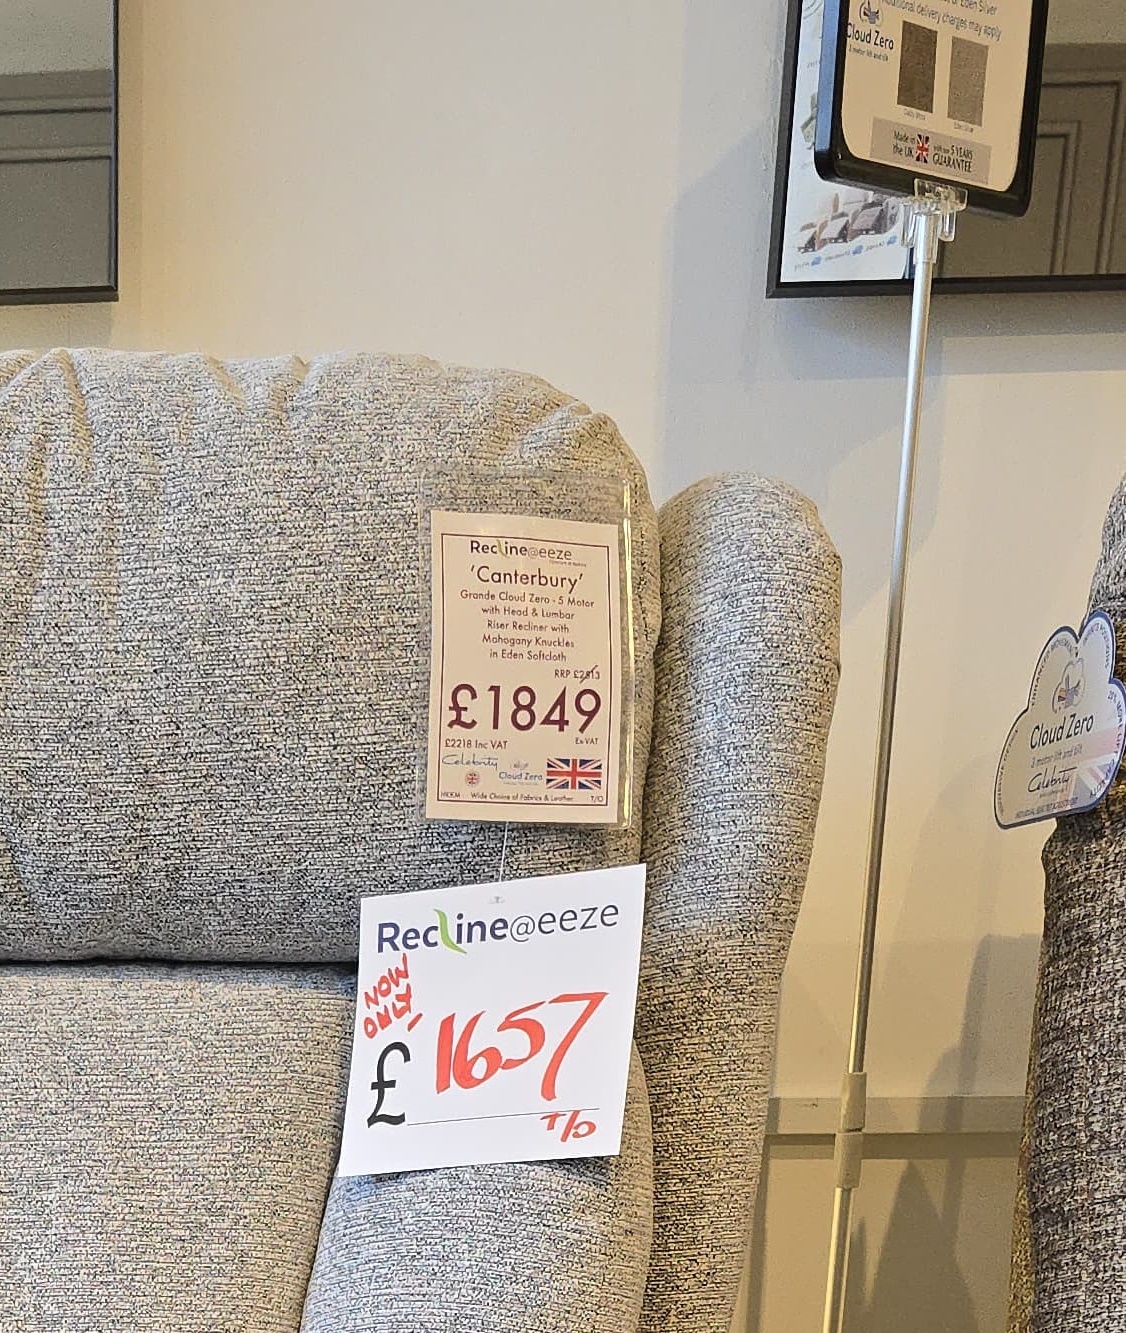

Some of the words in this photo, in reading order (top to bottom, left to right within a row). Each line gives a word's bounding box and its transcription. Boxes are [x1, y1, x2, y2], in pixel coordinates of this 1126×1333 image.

[917, 4, 940, 24] delivery
[942, 11, 967, 31] charges
[969, 21, 982, 36] may
[984, 25, 1002, 42] apply
[846, 22, 871, 44] Cloud
[874, 31, 894, 50] Zero
[894, 130, 909, 143] Made
[893, 143, 903, 155] the
[905, 146, 914, 159] UK
[956, 146, 973, 160] YEARS
[933, 152, 972, 173] GUARANTEE
[470, 539, 572, 560] Recline@eeze
[471, 565, 583, 594] 'Canterbury'
[460, 590, 495, 600] Grande
[499, 591, 525, 602] Cloud
[529, 593, 550, 604] Zero
[558, 596, 563, 605] 5
[567, 597, 594, 608] Motor
[481, 606, 500, 615] with
[504, 606, 528, 617] Head
[531, 609, 538, 617] &
[541, 608, 574, 620] Lumbar
[487, 620, 509, 630] Riser
[512, 621, 548, 632] Recliner
[551, 623, 569, 633] with
[482, 634, 532, 647] Mahogany
[535, 636, 575, 648] Knuckles
[490, 649, 497, 658] in
[501, 650, 524, 660] Eden
[527, 650, 566, 662] Softcloth
[554, 669, 571, 679] RRP
[447, 683, 601, 734] £1849
[1029, 716, 1066, 749] Cloud
[1066, 713, 1094, 740] Zero
[444, 738, 472, 748] £2218
[475, 739, 488, 749] Inc
[490, 739, 508, 750] VAT
[585, 737, 598, 745] VAT
[441, 752, 498, 771] Celebrity
[499, 771, 523, 781] Cloud
[524, 771, 543, 781] Zero
[377, 903, 619, 954] Recline@eeze
[364, 953, 410, 1009] NOW
[364, 983, 413, 1038] ONLY
[368, 1041, 411, 1128] £
[436, 992, 610, 1101] 1657
